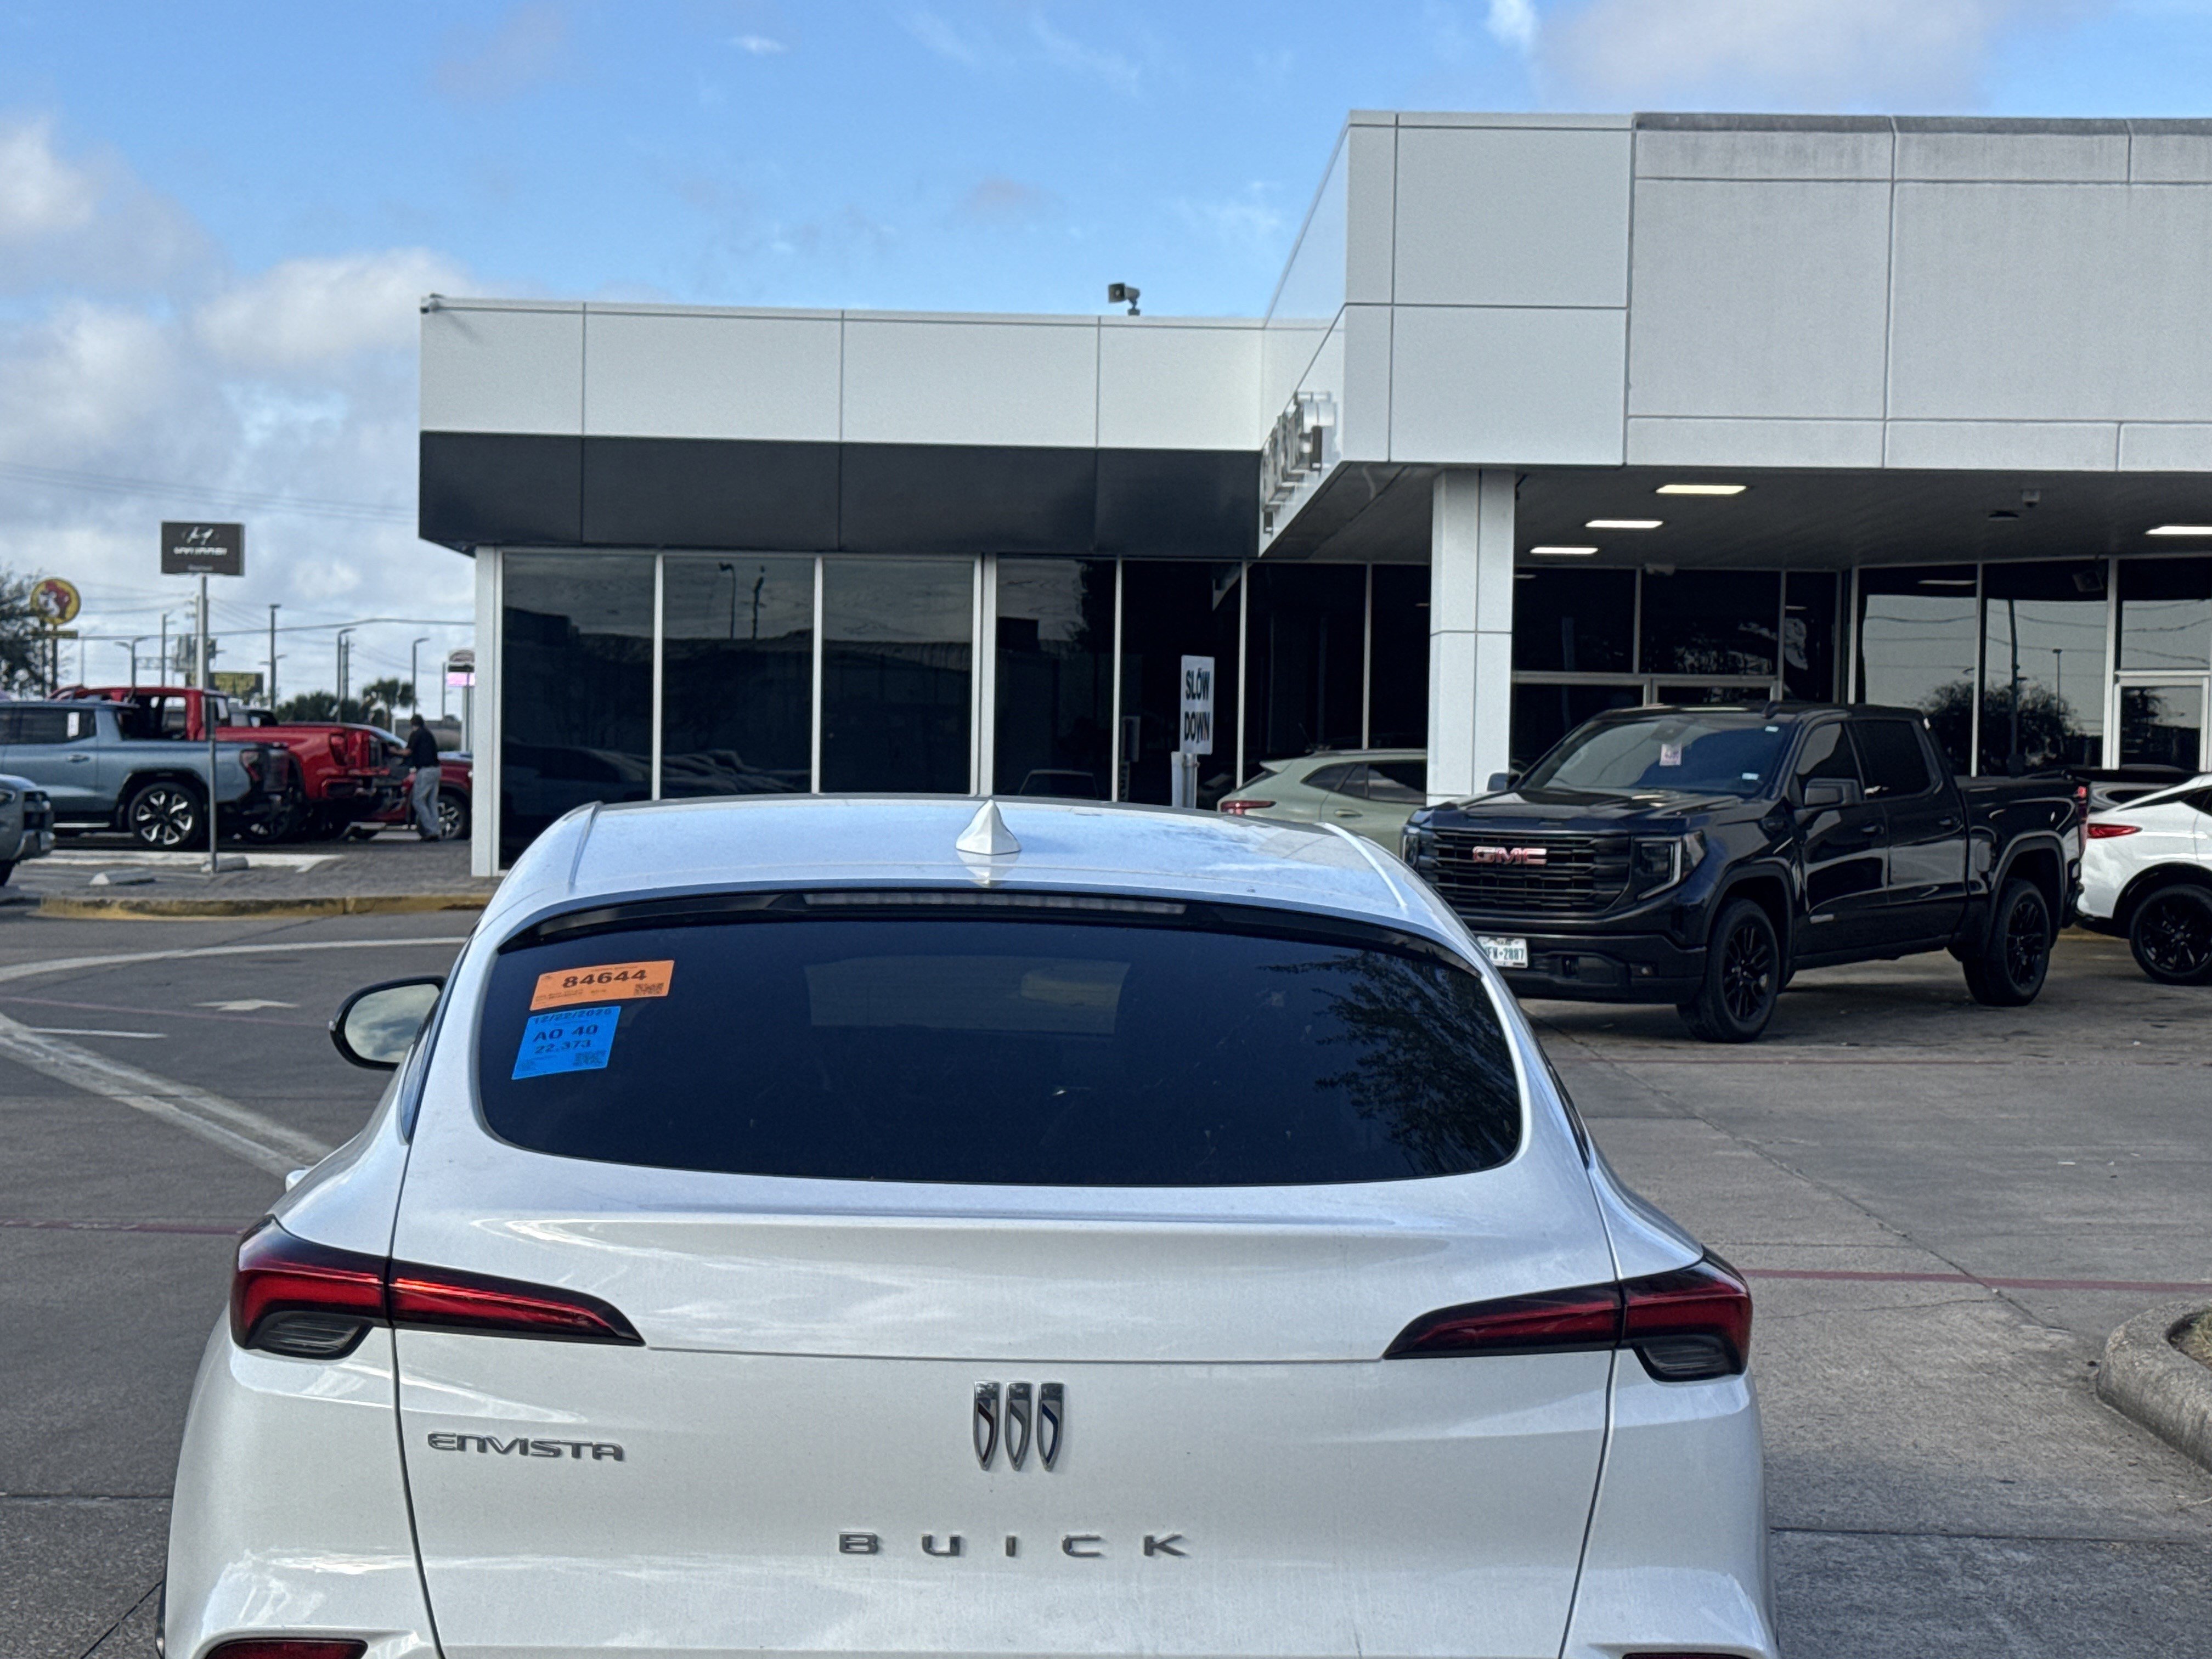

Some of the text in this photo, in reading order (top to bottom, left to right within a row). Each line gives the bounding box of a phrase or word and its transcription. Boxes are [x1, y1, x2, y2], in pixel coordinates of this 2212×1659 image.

[1185, 668, 1210, 701] SLOW
[1184, 711, 1210, 743] DOWN
[1472, 846, 1547, 865] GMC
[562, 969, 647, 989] 84644
[572, 1024, 598, 1036] 40
[428, 1431, 623, 1461] ENVISTA
[839, 1533, 1187, 1556] BUICK
